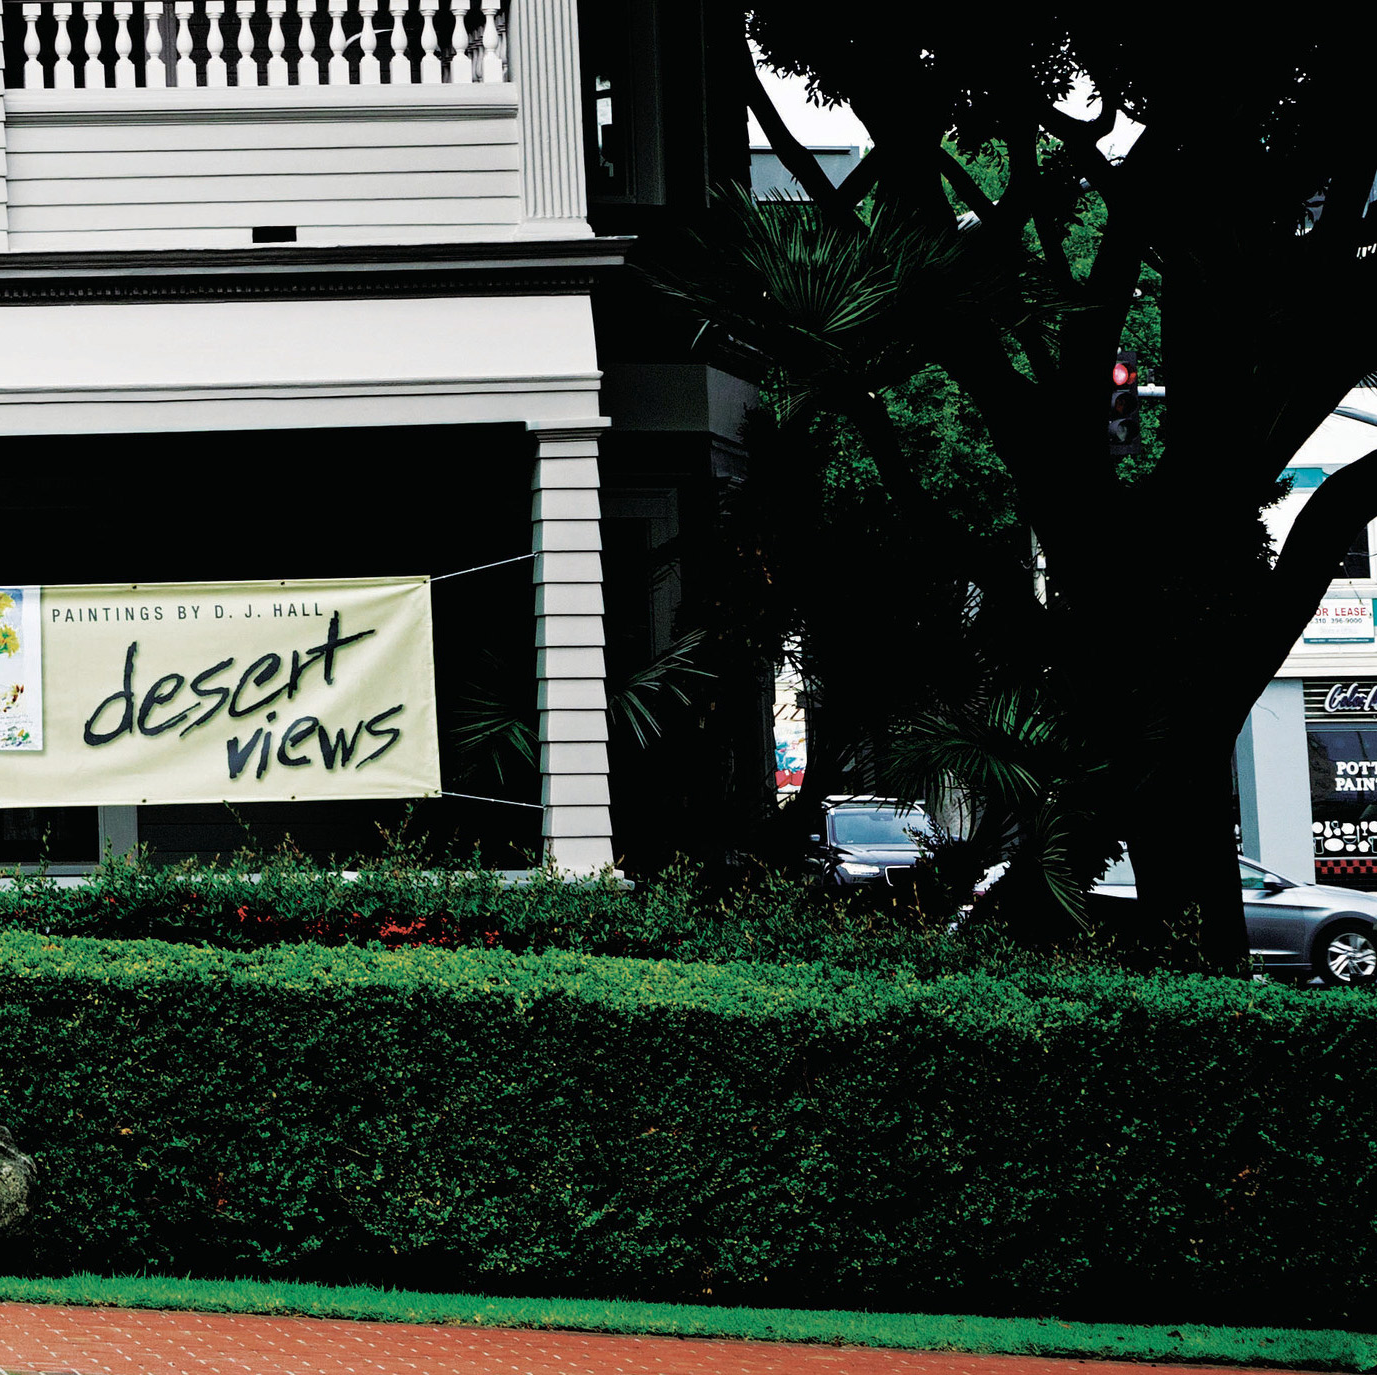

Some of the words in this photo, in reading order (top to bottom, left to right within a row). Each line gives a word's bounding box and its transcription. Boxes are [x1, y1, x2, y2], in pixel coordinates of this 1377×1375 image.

[52, 606, 164, 623] PAINTINGS
[177, 605, 200, 620] BY
[214, 605, 234, 619] D.
[244, 603, 262, 619] J.
[273, 602, 324, 618] HALL
[1315, 607, 1329, 617] OR
[1334, 607, 1367, 617] LEASE
[82, 610, 377, 747] desert
[226, 704, 404, 780] views
[1335, 777, 1377, 791] PAIN
